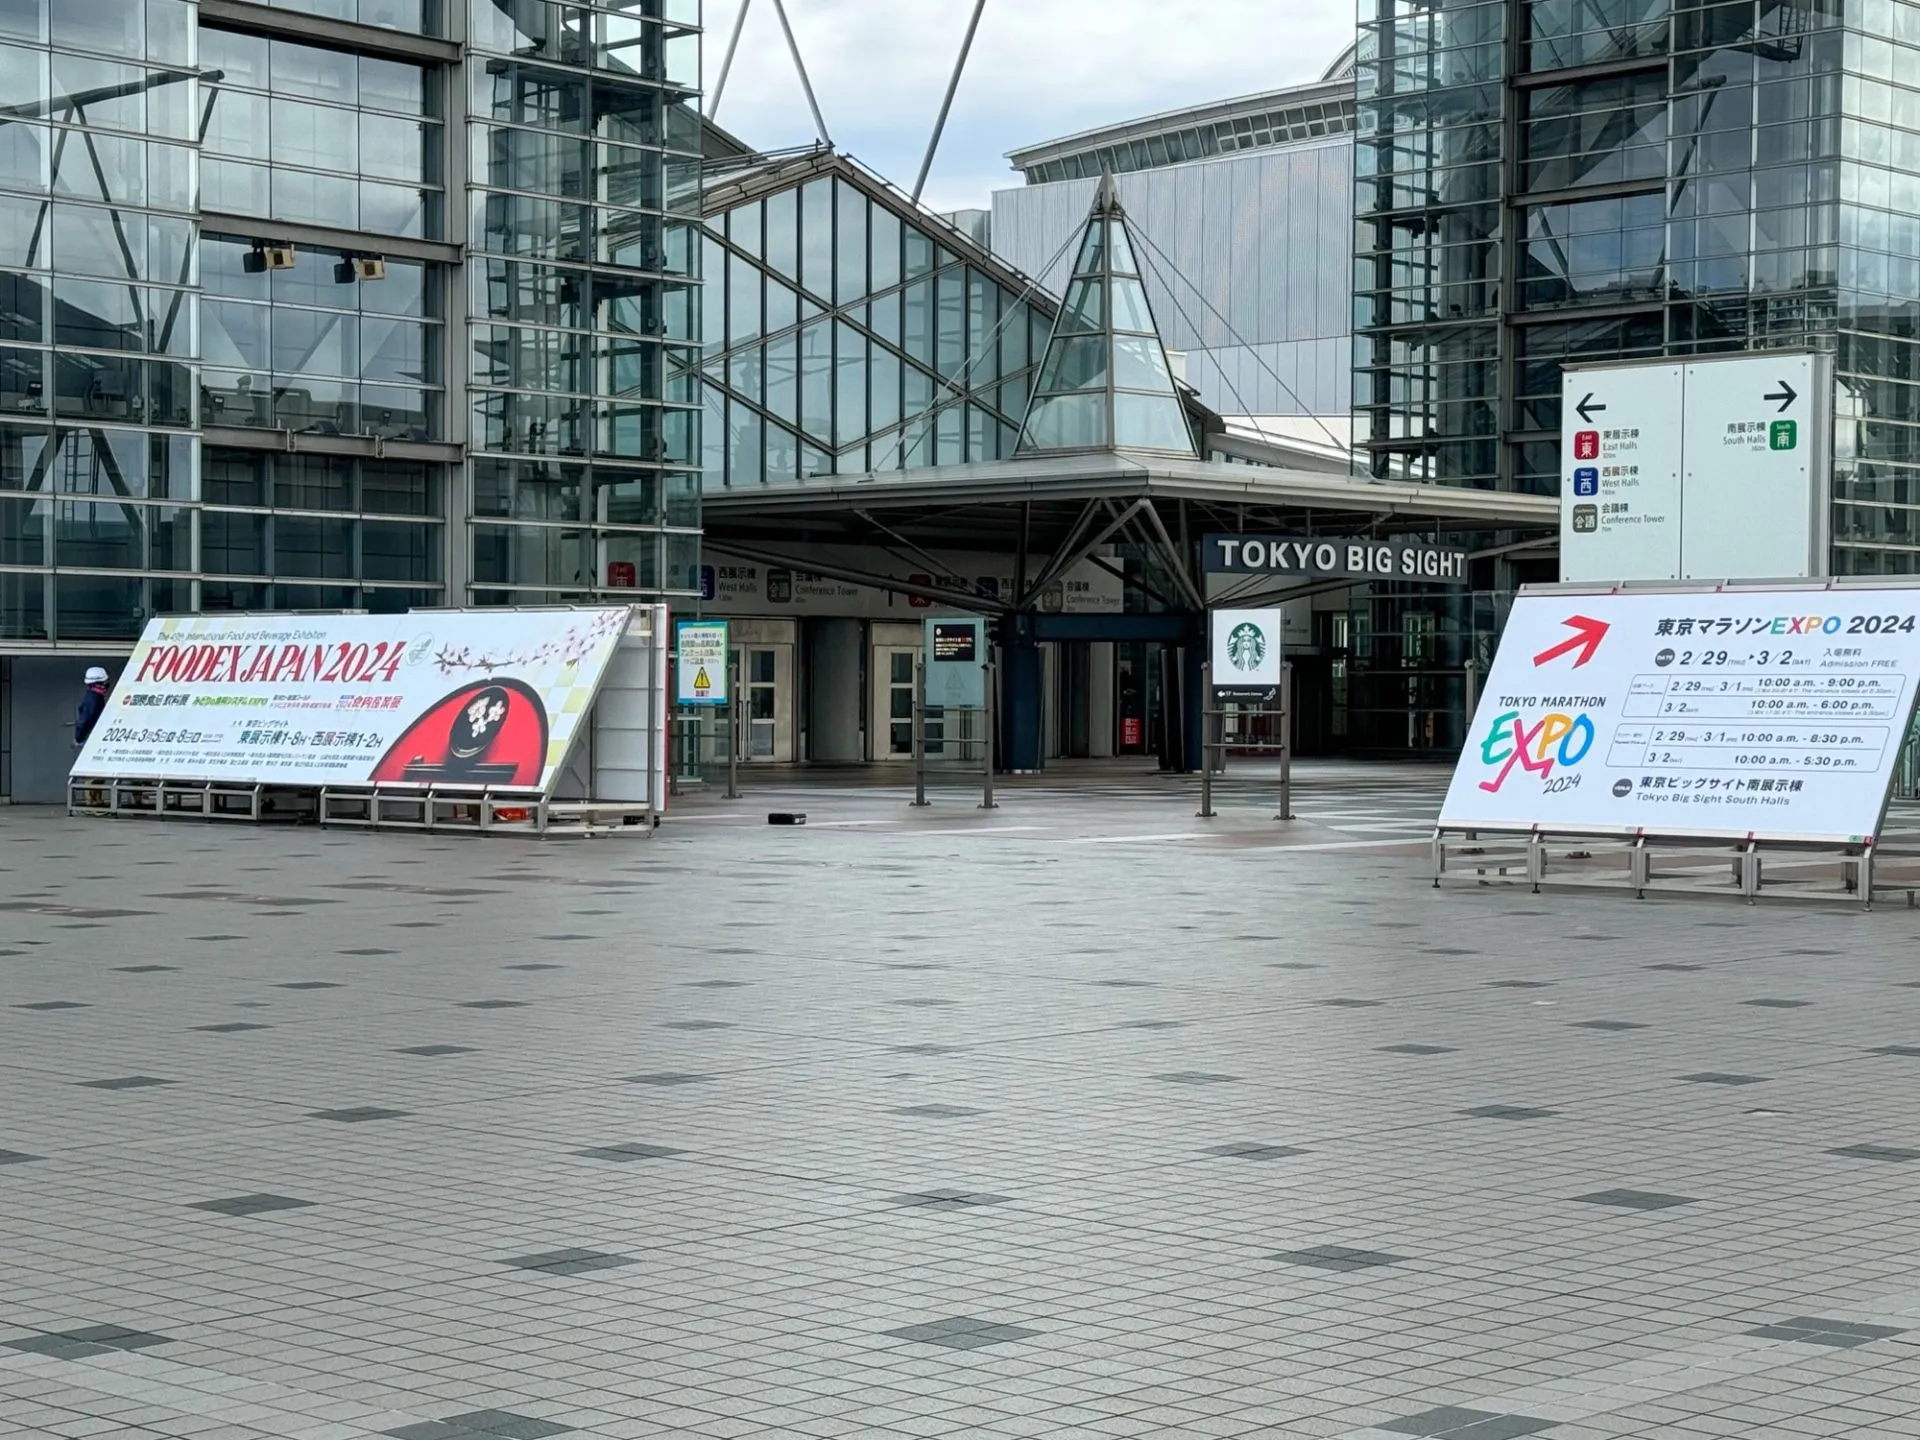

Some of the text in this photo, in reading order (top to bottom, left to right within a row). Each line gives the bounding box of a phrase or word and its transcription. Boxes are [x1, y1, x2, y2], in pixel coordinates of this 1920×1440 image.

[1603, 429, 1640, 440] 東展示棟
[1727, 421, 1766, 434] 南展示棟
[1603, 441, 1638, 451] East Halls
[1722, 434, 1766, 445] South Halls
[1777, 431, 1790, 448] 南
[1581, 442, 1592, 458] 東
[1602, 465, 1639, 477] 西展示棟
[1581, 478, 1592, 494] 西
[1602, 478, 1640, 488] West Halls
[1601, 513, 1666, 525] Conference Tower
[1217, 540, 1465, 578] TOKYO BIG SIGHT
[718, 581, 738, 593] West
[794, 585, 859, 597] Conference Tower
[1846, 615, 1916, 634] 2024
[226, 631, 245, 640] Food
[134, 641, 407, 683] FOODEX JAPAN 2024
[1679, 650, 1728, 666] 2/29
[1756, 650, 1793, 666] 3/2
[1819, 659, 1899, 668] Admission FREE
[1671, 681, 1702, 692] 2/29
[1720, 681, 1742, 692] 3/1
[1757, 678, 1791, 688] 10:00
[1792, 680, 1817, 688] a.m.
[1827, 678, 1856, 688] 9:00
[1857, 680, 1882, 689] p.m.
[1498, 696, 1608, 708] TOKYO MARATHON
[1664, 702, 1688, 713] 3/2
[1751, 699, 1785, 710] 10:00
[1786, 701, 1810, 710] a.m.
[1820, 700, 1849, 710] 6:00
[1850, 701, 1875, 711] p.m.
[1655, 731, 1686, 742] 2/29
[1703, 731, 1727, 742] 3/1
[1741, 733, 1774, 743] 10:00
[1775, 734, 1800, 743] a.m.
[1809, 734, 1839, 744] 8:30
[1840, 736, 1865, 745] p.m.
[1479, 711, 1595, 793] EXPO
[1648, 752, 1672, 763] 3/2
[1734, 755, 1767, 765] 10:00
[1768, 756, 1793, 766] a.m.
[1803, 756, 1832, 767] 5:30
[1833, 758, 1858, 768] p.m.
[1542, 773, 1581, 795] 2024
[1638, 776, 1805, 792] 東京ビッグサイト南展示棟
[1635, 792, 1790, 806] Tokyo Big Sight South Halls
